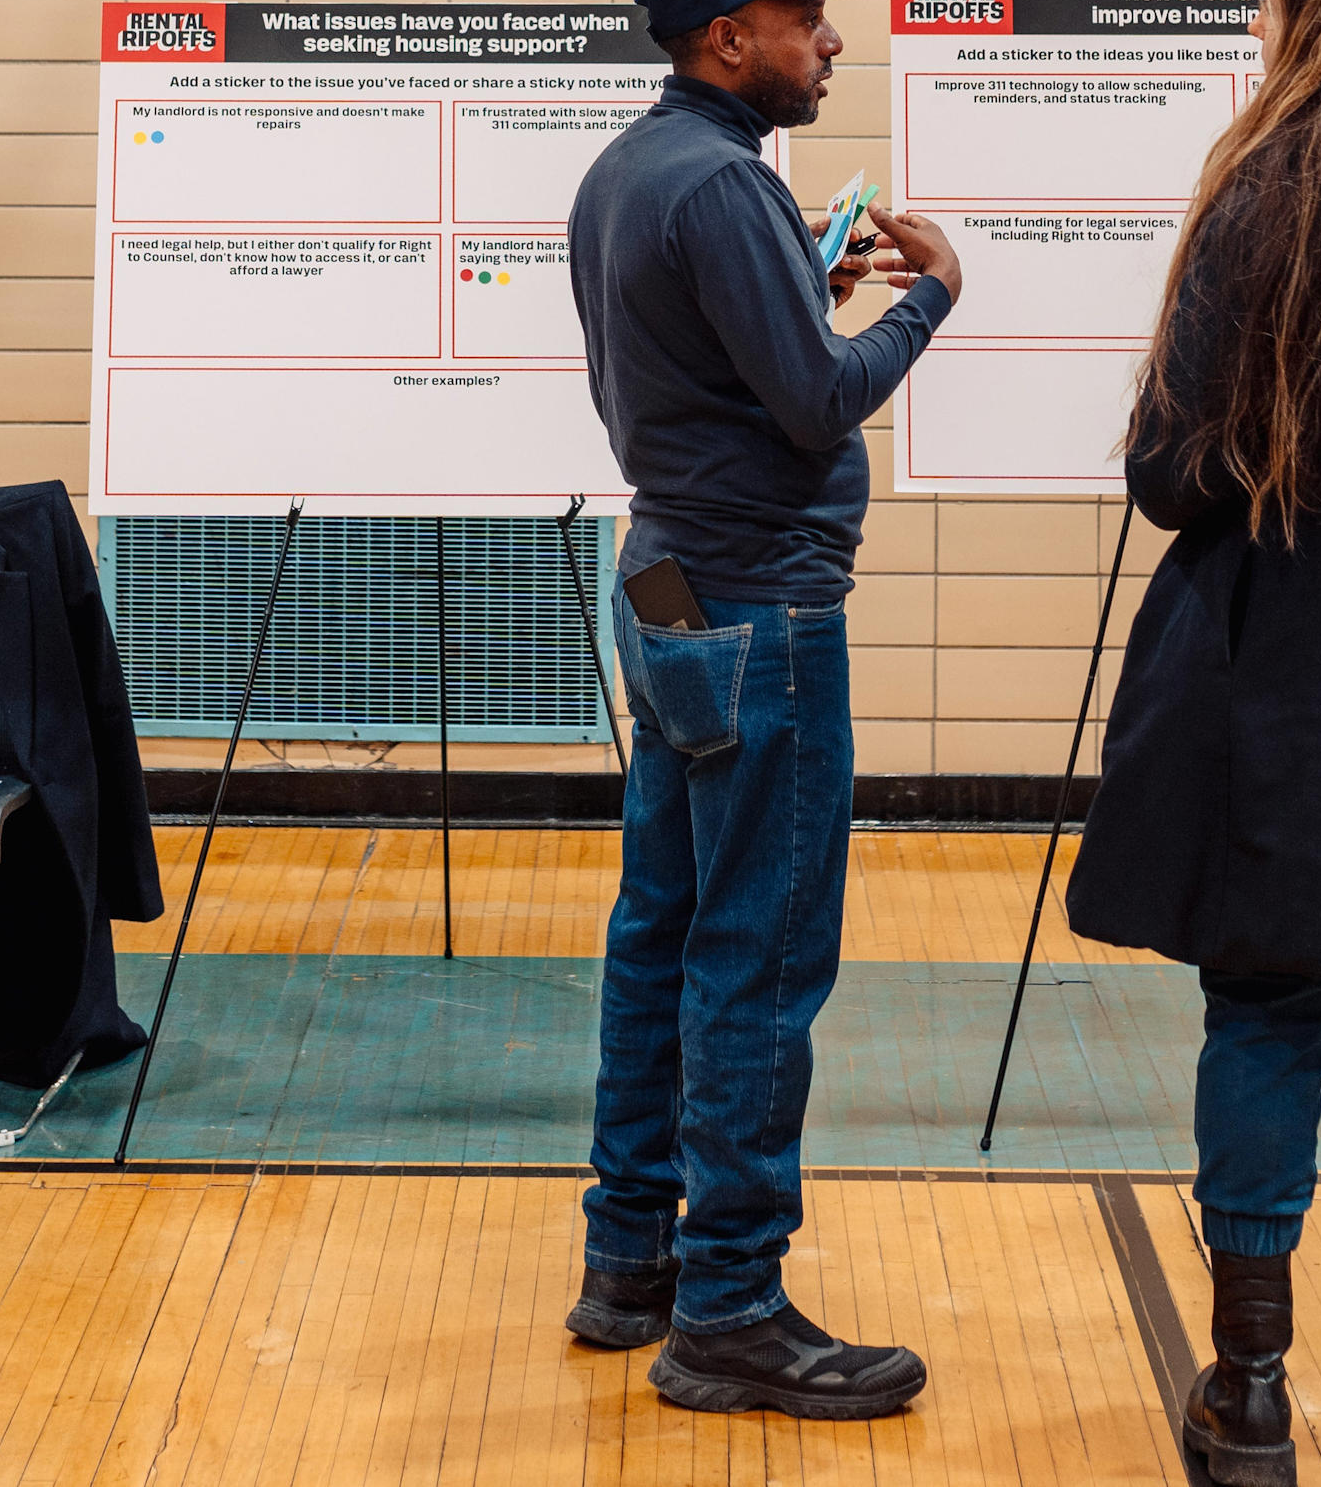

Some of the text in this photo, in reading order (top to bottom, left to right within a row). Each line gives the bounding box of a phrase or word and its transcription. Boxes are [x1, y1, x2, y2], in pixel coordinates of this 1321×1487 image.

[906, 1, 1004, 22] RIPOFFS
[1092, 4, 1260, 26] improve housin
[128, 13, 208, 30] RENTAL
[261, 12, 629, 33] What issues have you faced when
[119, 30, 216, 50] RIPOFFS
[303, 34, 587, 56] seeking housing support?
[957, 48, 1258, 62] Add a sticker to the ideas you like best or
[169, 76, 646, 90] Add a sticker to the issue you've faced or share a sticky note with
[934, 80, 1205, 94] Improve 311 technology to allow scheduling,
[973, 93, 1166, 105] reminders, and status tracking
[132, 106, 424, 117] My landlord is not responsive and doesn't make
[256, 119, 300, 130] repairs
[964, 217, 1177, 231] Expand funding for legal services,
[991, 231, 1153, 242] including Right to Counsel
[127, 239, 158, 248] need
[161, 239, 191, 251] legal
[194, 239, 224, 253] help,
[227, 239, 248, 249] but
[257, 239, 294, 249] either
[297, 240, 329, 249] don't
[332, 239, 375, 253] qualify
[378, 239, 396, 249] for
[399, 240, 432, 252] Right
[127, 251, 425, 263] to Counsel, don't know how to access it, or can't
[229, 265, 324, 277] afford a lawyer
